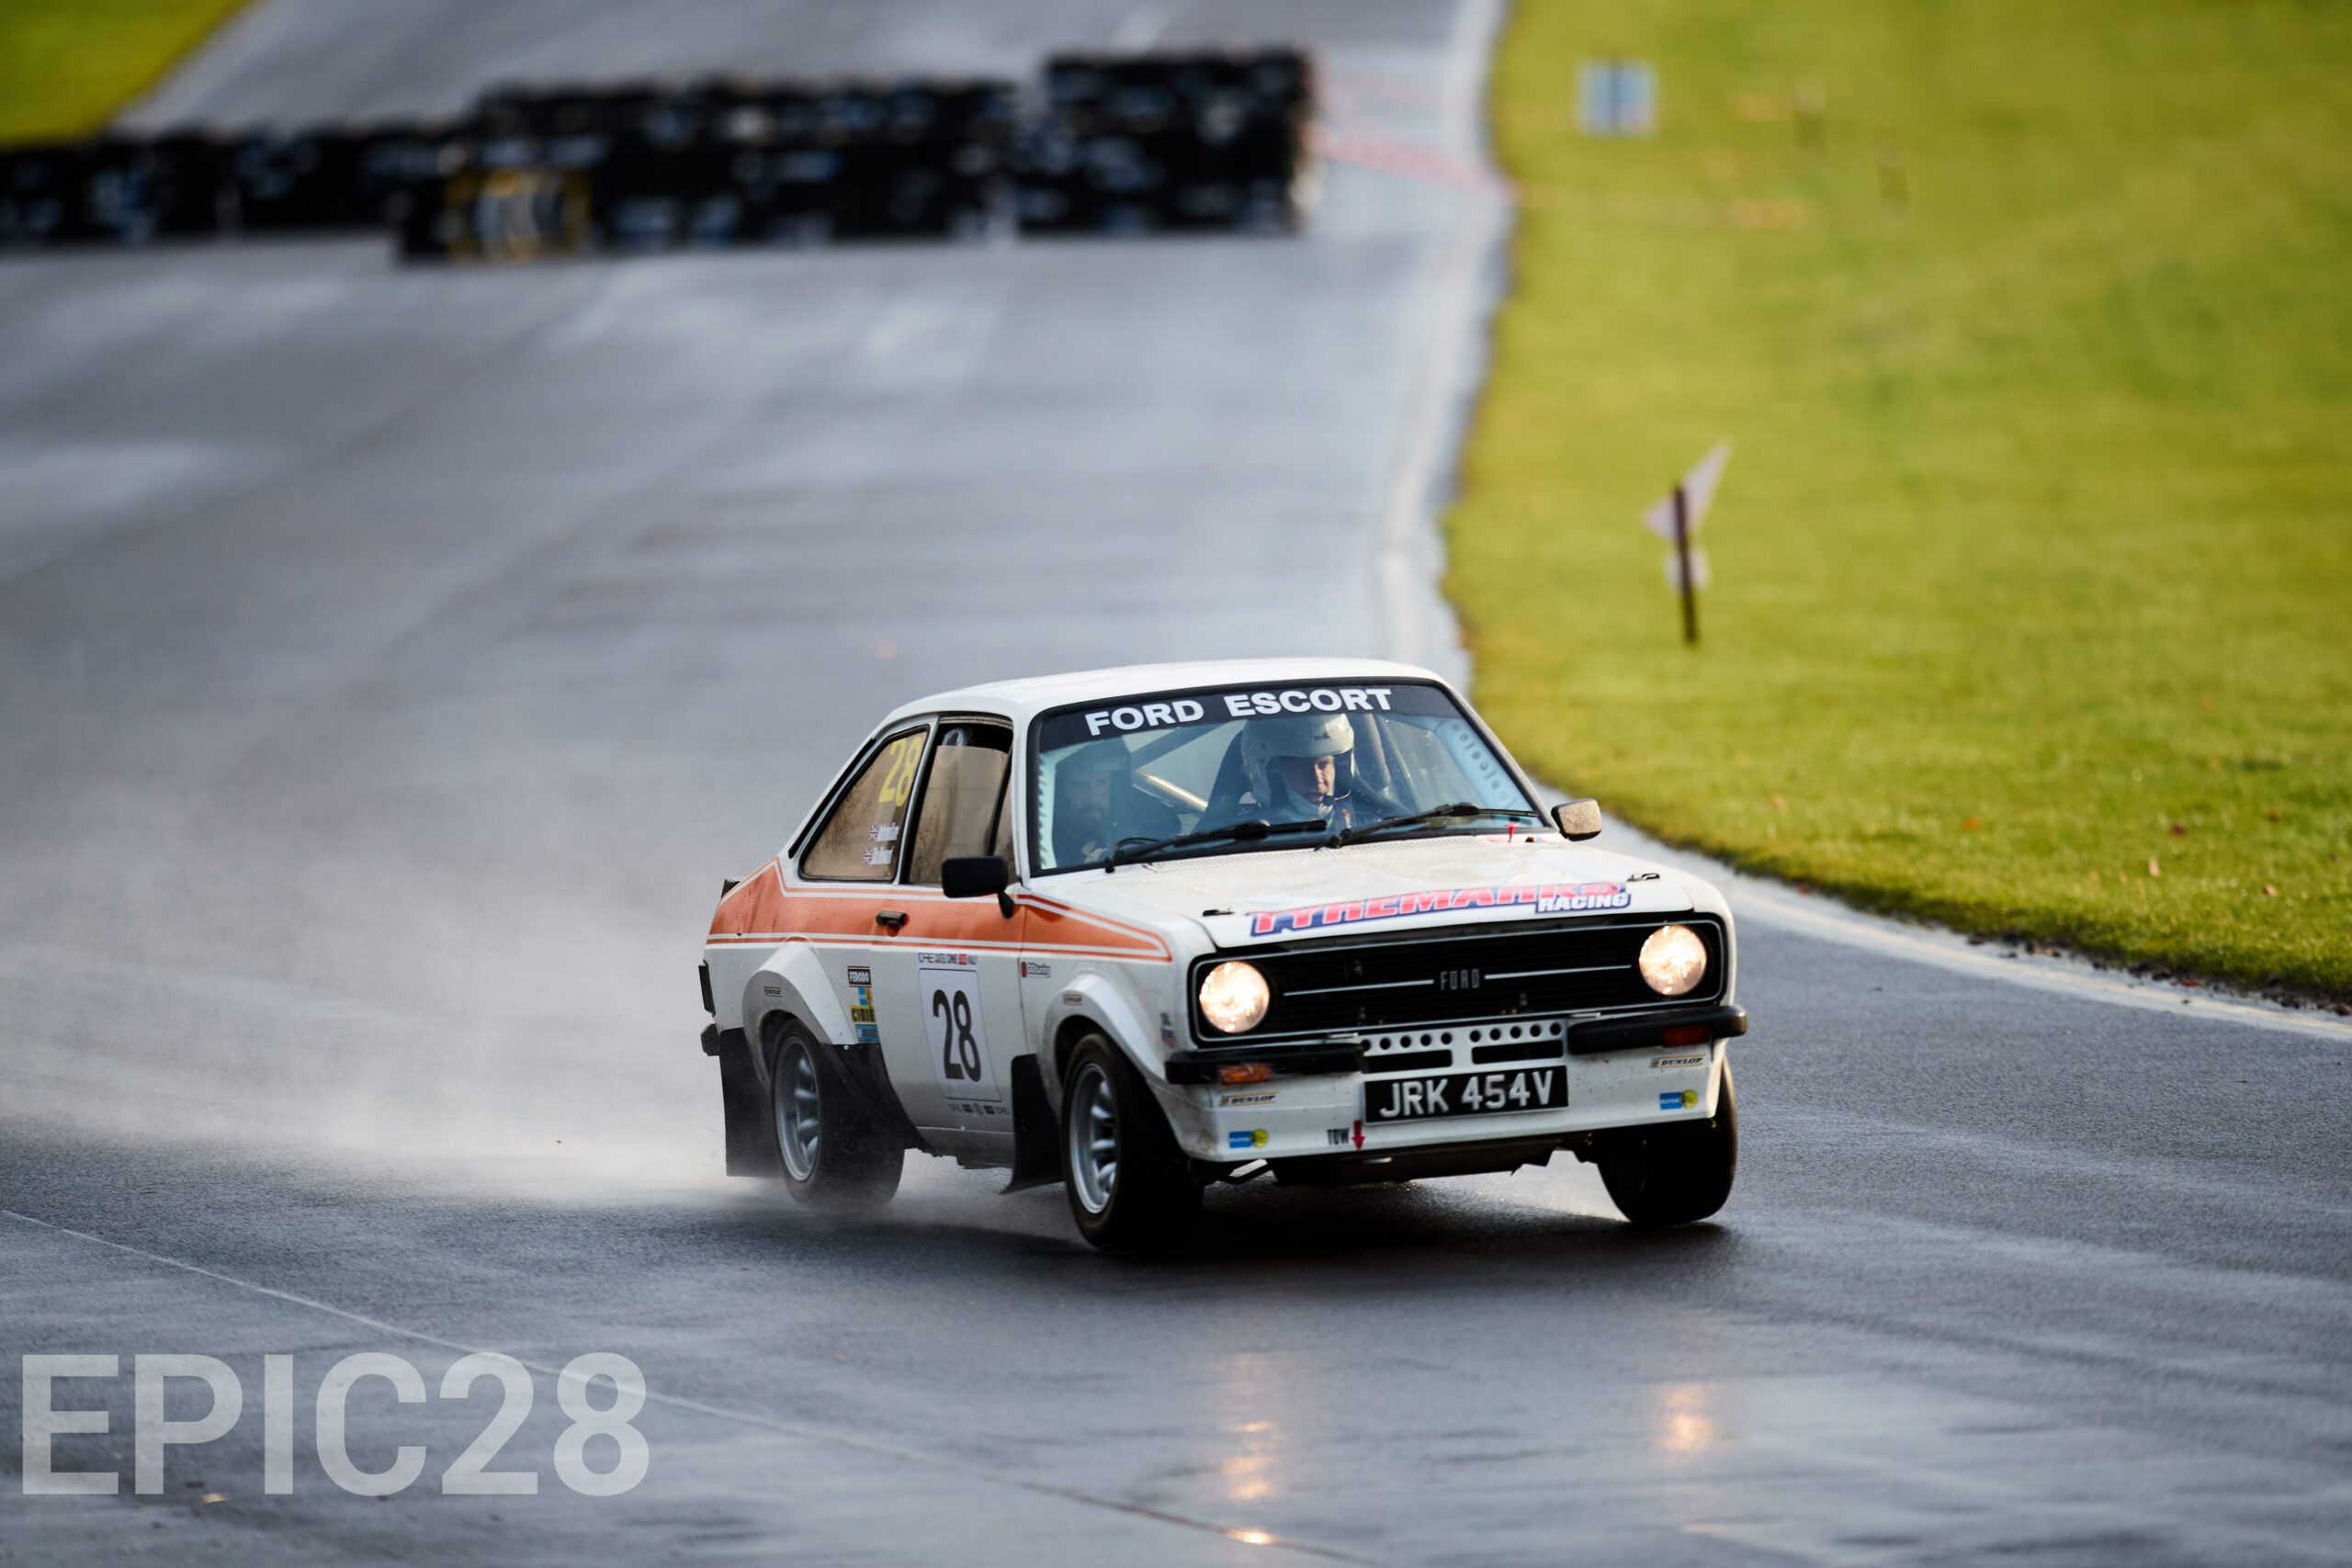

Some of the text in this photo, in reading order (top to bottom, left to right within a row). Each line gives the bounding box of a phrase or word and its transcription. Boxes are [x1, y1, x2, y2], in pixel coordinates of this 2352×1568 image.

[1084, 688, 1392, 736] FORD ESCORT
[878, 736, 922, 807] 28
[1537, 893, 1630, 913] RACING
[1440, 969, 1480, 991] FORD
[933, 989, 981, 1082] 28
[1661, 1057, 1703, 1066] DUNLOP
[1231, 1095, 1276, 1104] DUNLOP
[1379, 1070, 1554, 1118] JRK 454V
[1327, 1128, 1350, 1145] TOW
